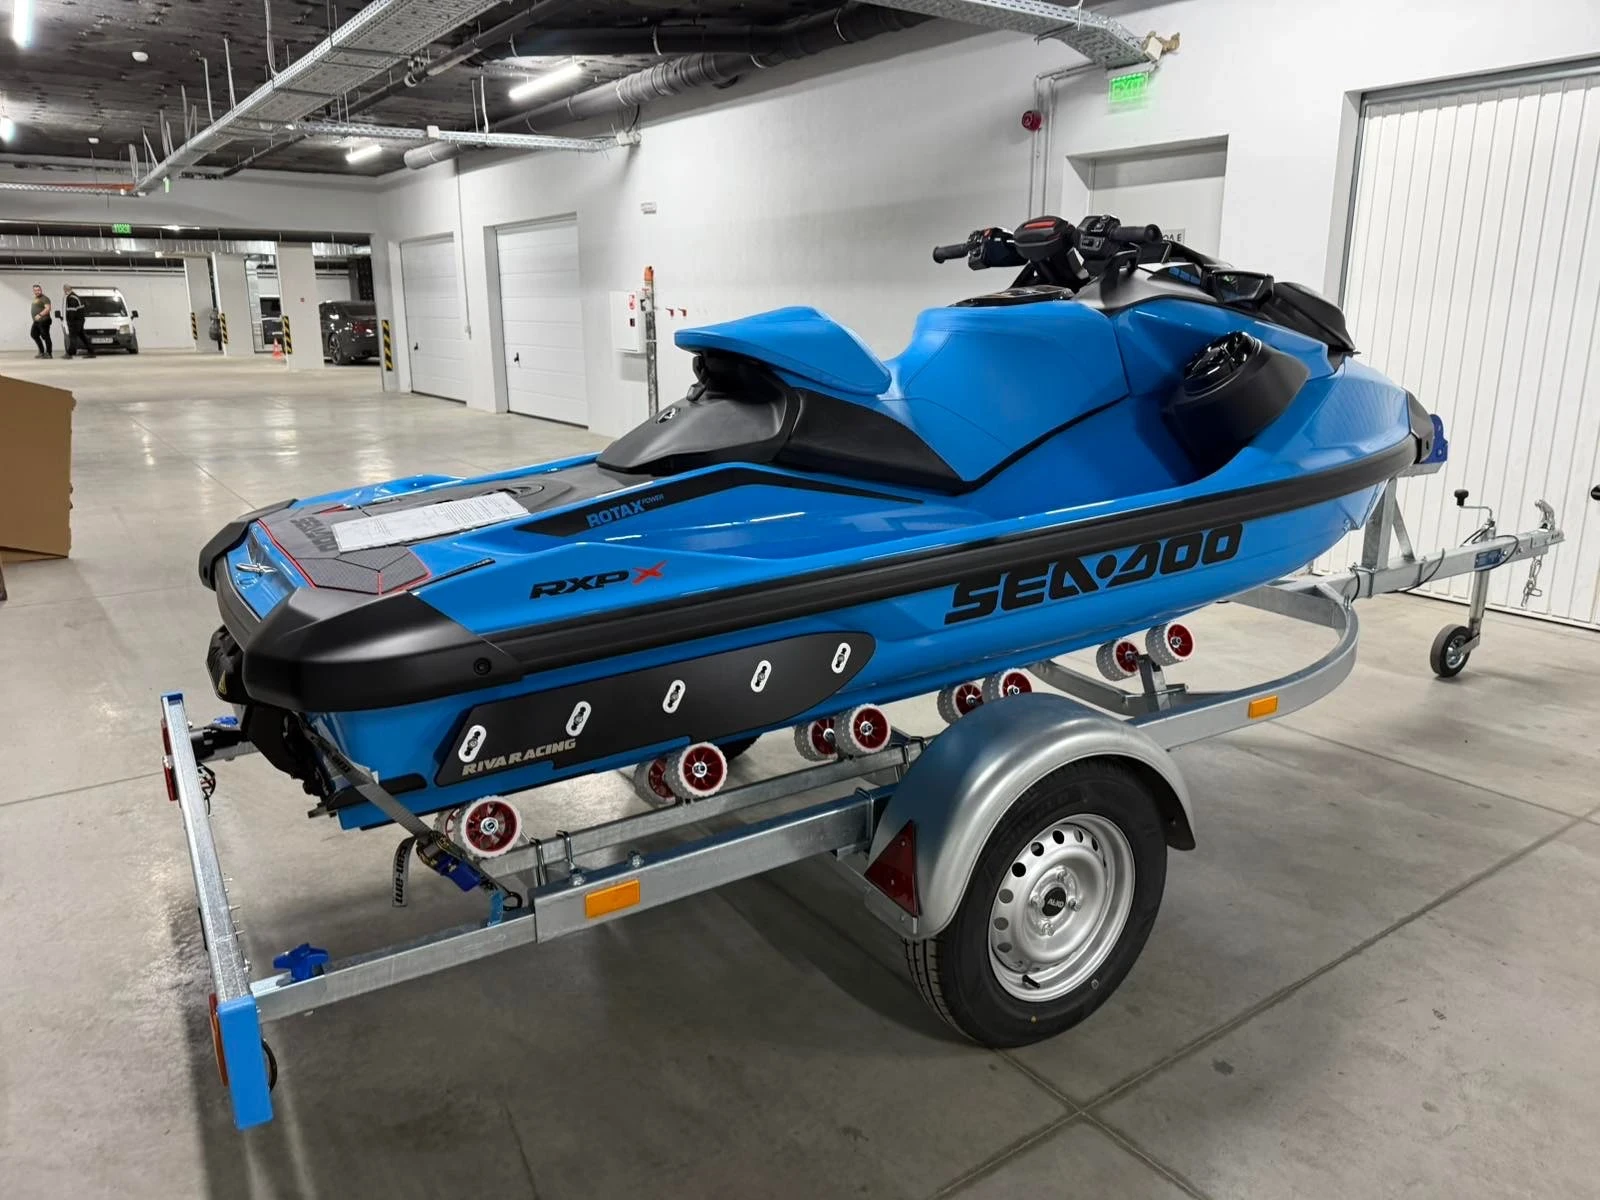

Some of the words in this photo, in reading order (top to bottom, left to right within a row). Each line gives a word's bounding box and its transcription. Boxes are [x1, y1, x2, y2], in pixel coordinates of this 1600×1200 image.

[586, 500, 645, 528] ROTAX
[642, 493, 665, 505] POWER
[462, 755, 508, 776] RIVA
[508, 738, 577, 763] RACING
